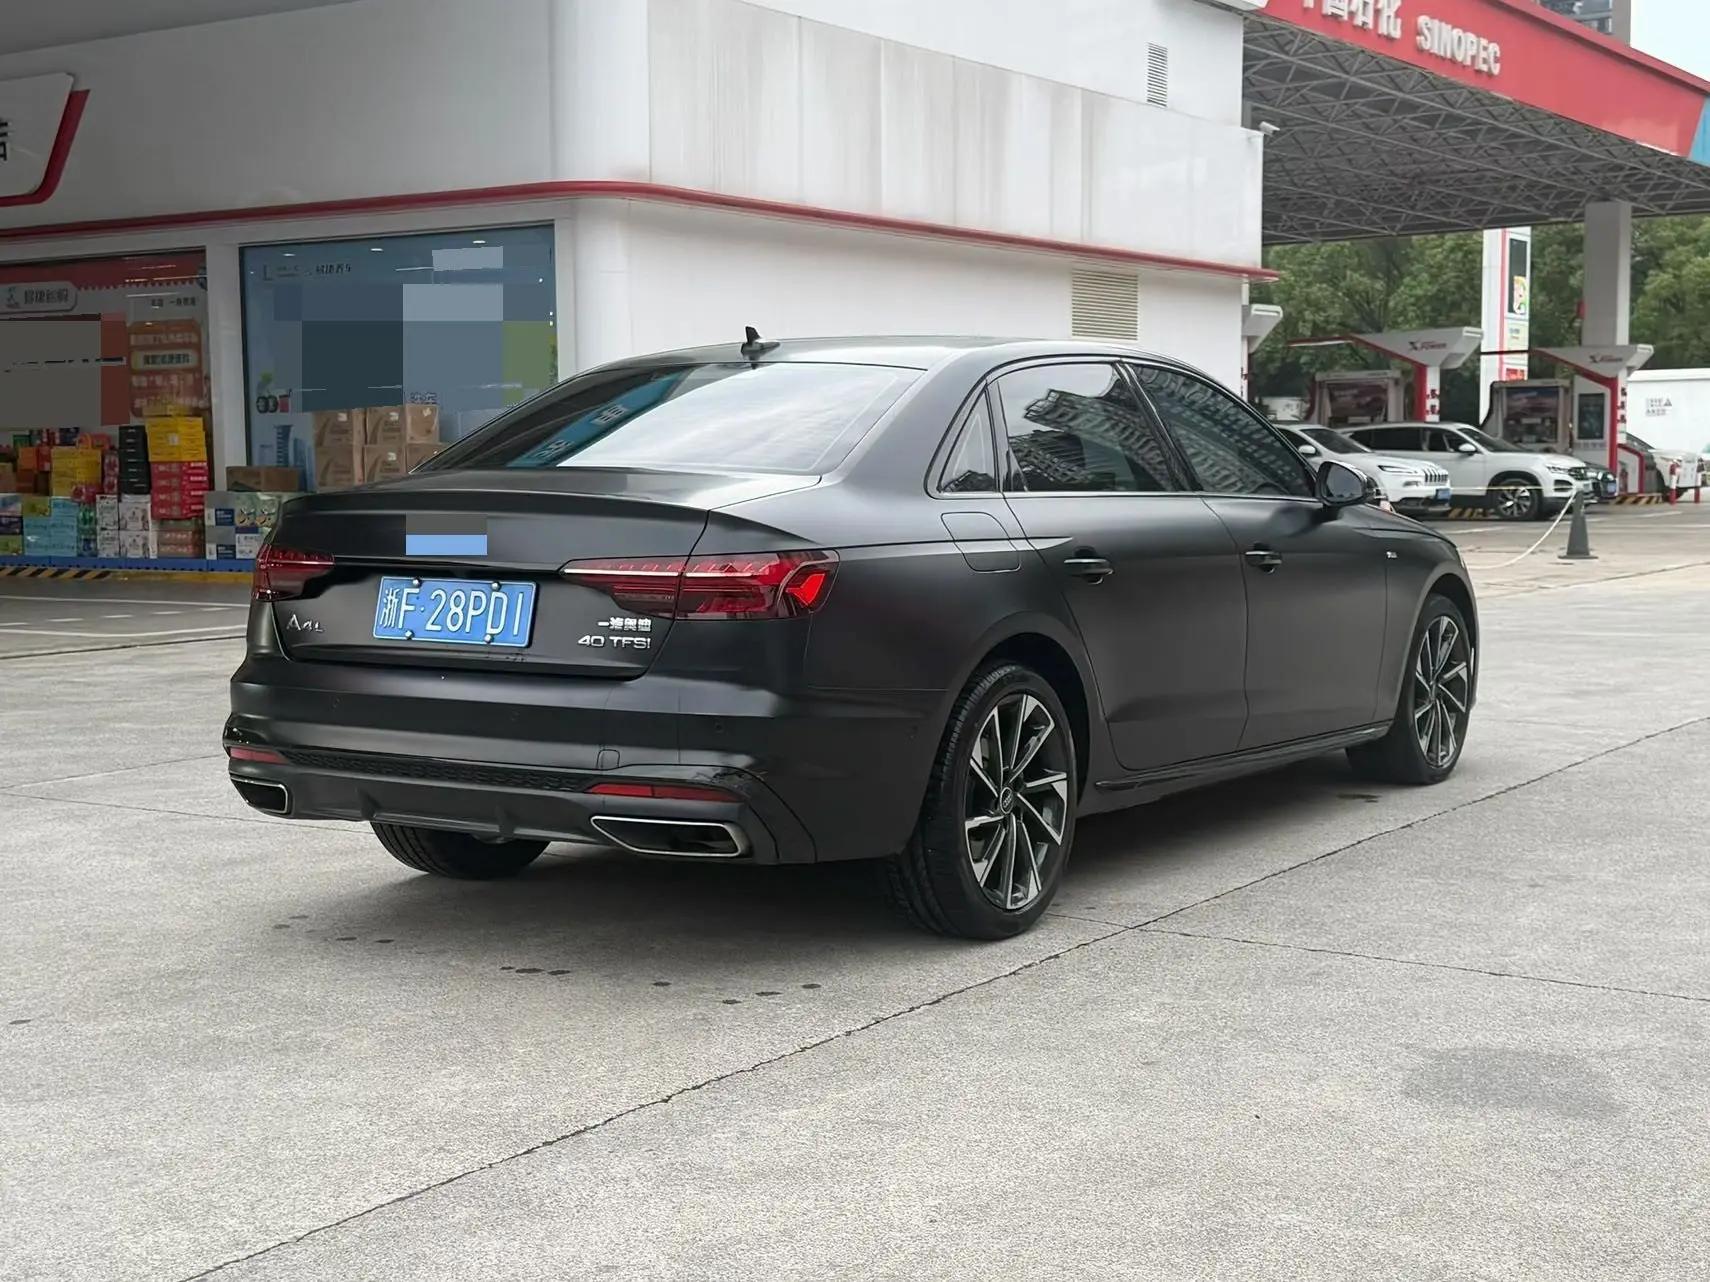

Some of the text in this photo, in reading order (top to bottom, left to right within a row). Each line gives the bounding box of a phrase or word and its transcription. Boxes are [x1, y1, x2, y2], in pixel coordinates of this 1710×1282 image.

[1303, 0, 1401, 39] 国石化
[1416, 15, 1500, 75] SINOPEC
[577, 635, 651, 649] 40 TFSI
